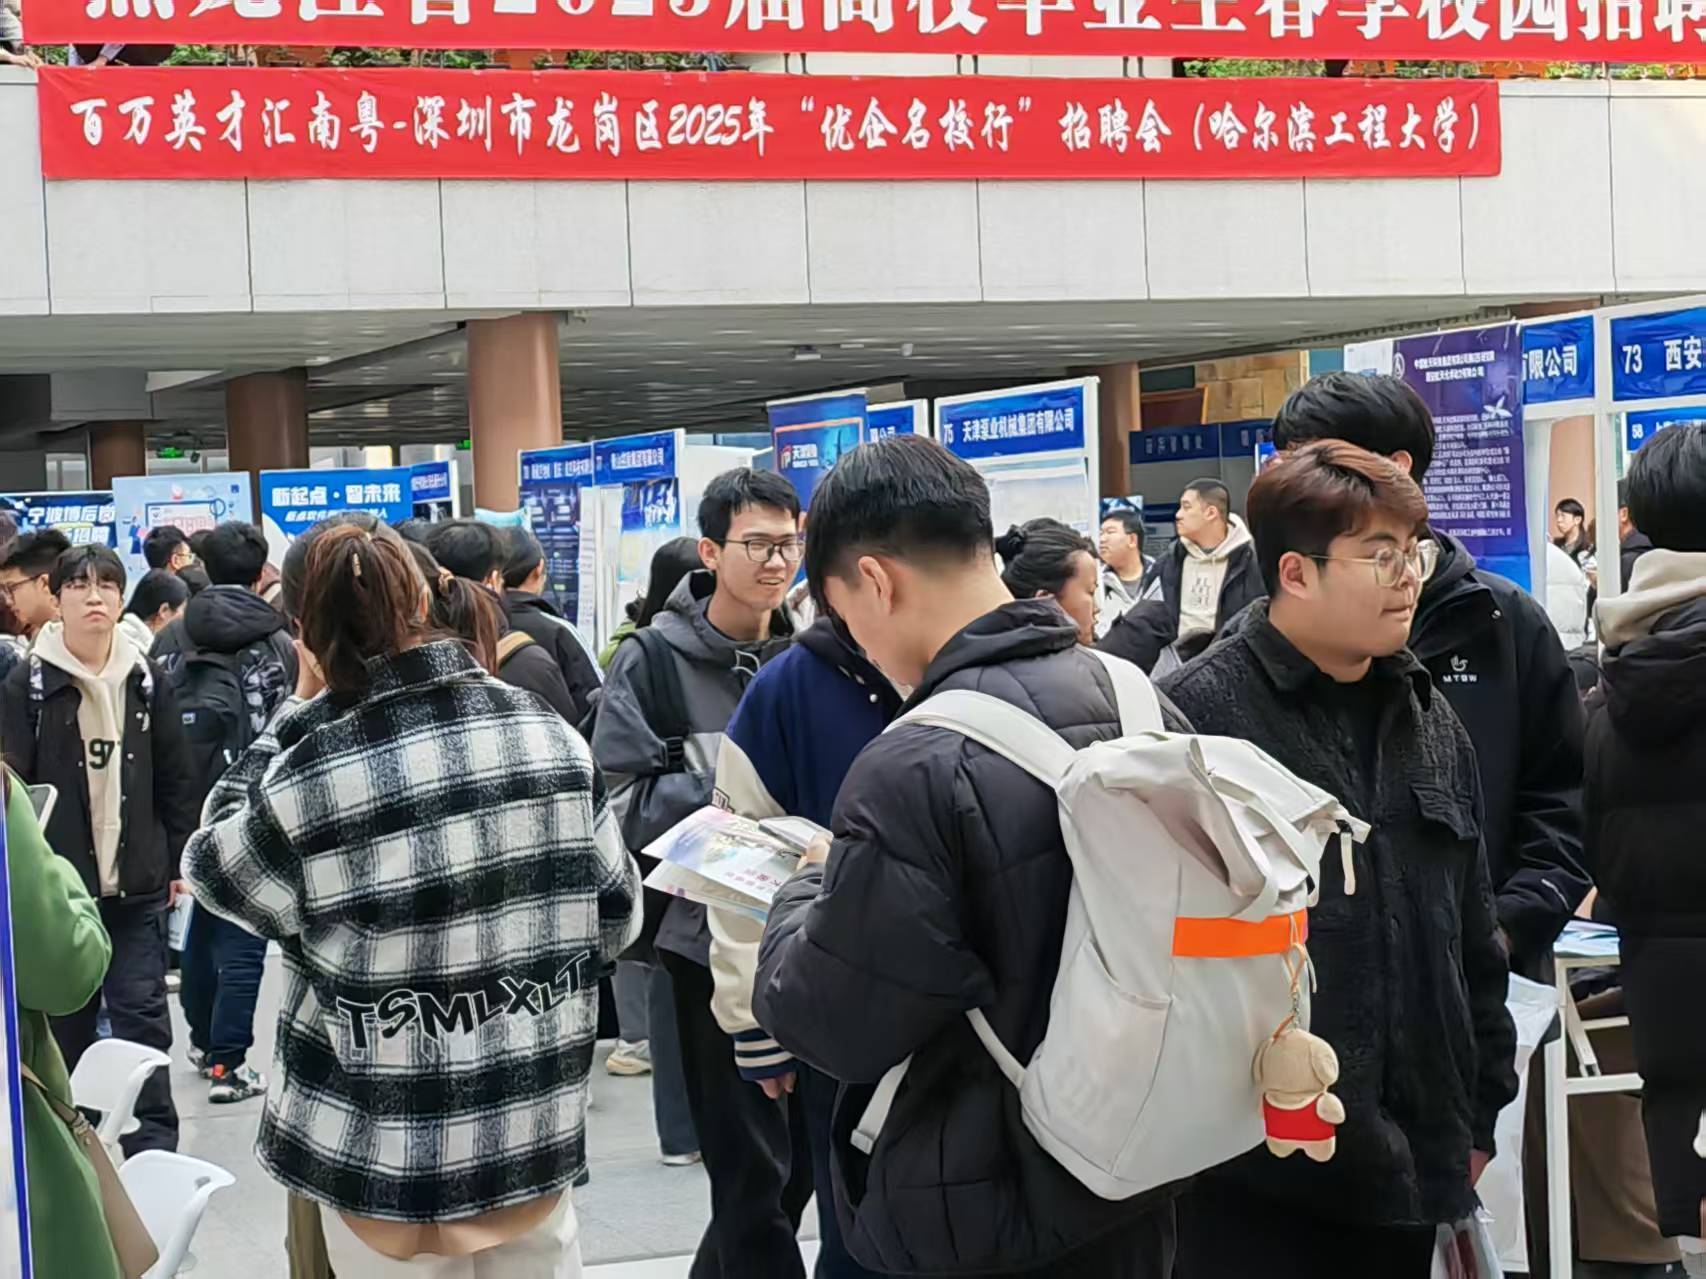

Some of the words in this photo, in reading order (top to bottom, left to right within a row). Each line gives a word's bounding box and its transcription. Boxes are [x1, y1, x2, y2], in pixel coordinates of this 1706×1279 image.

[1622, 344, 1643, 374] 73
[1664, 335, 1706, 371] 西安
[88, 738, 115, 769] 97
